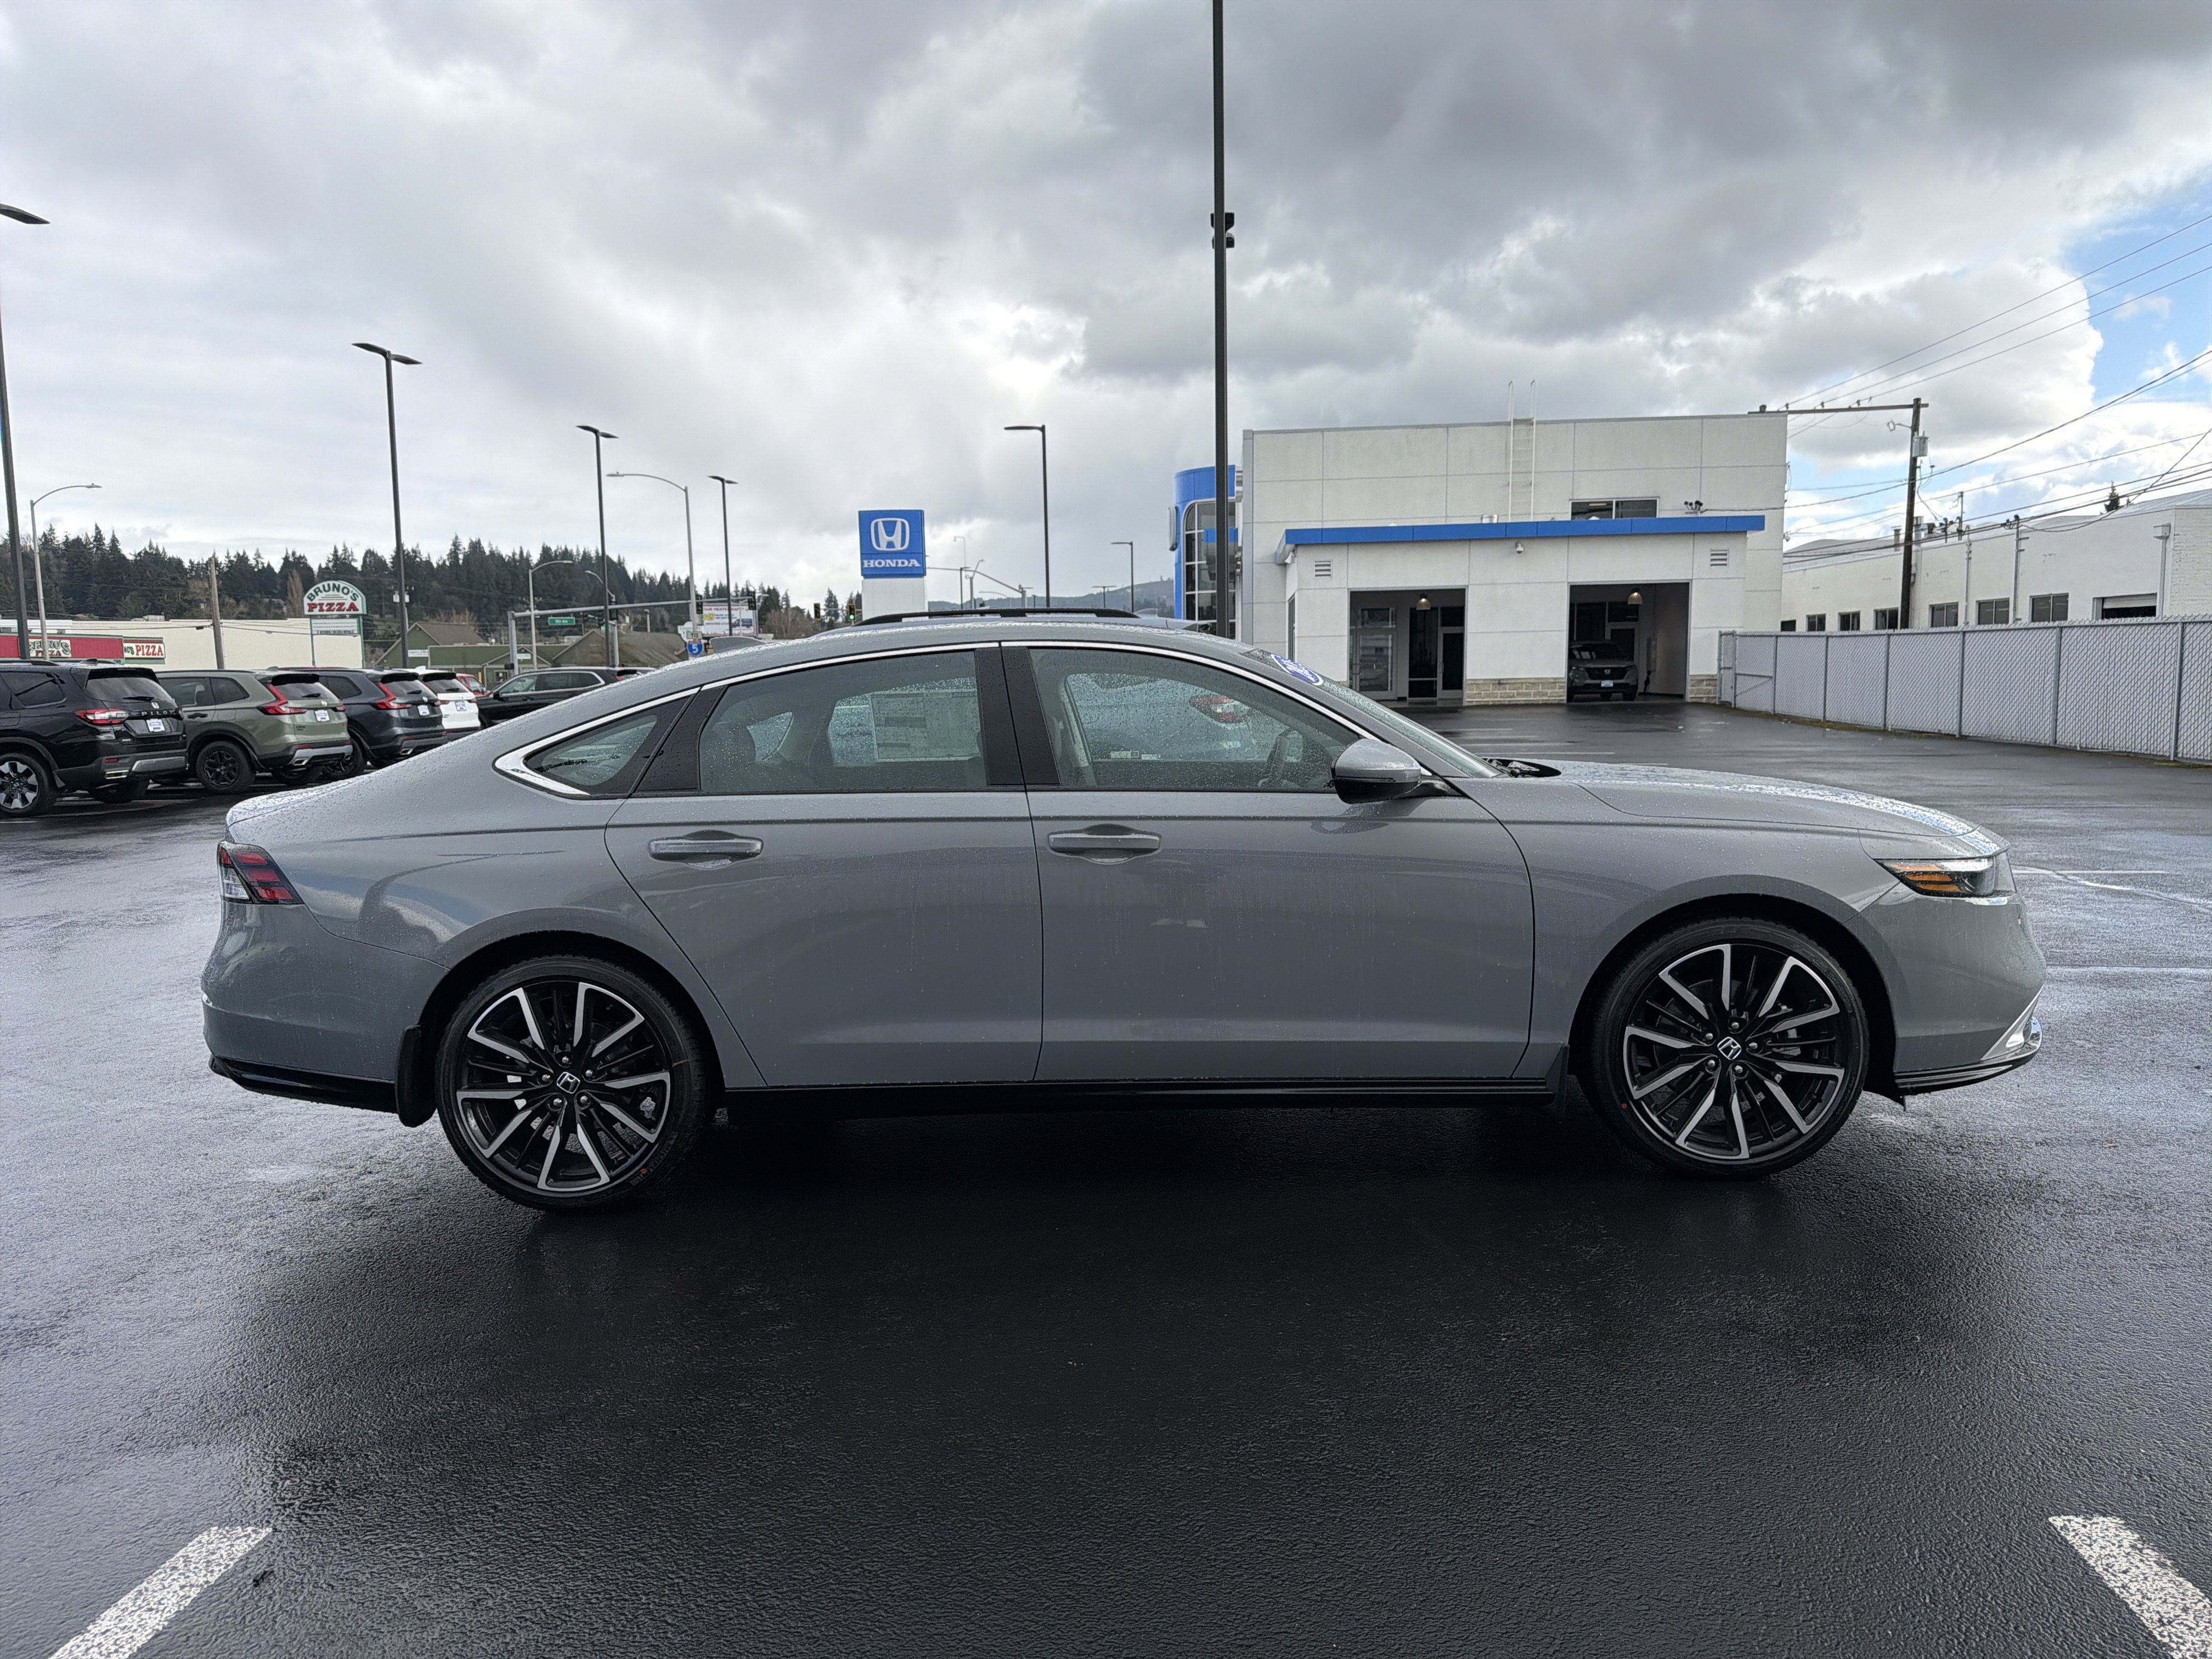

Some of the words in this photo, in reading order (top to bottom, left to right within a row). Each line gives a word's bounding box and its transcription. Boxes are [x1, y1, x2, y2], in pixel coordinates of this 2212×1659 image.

[862, 559, 921, 568] HONDA
[306, 583, 359, 602] BRUNO'S
[307, 602, 359, 612] PIZZA
[135, 645, 164, 656] PIZZA
[692, 644, 699, 653] 5
